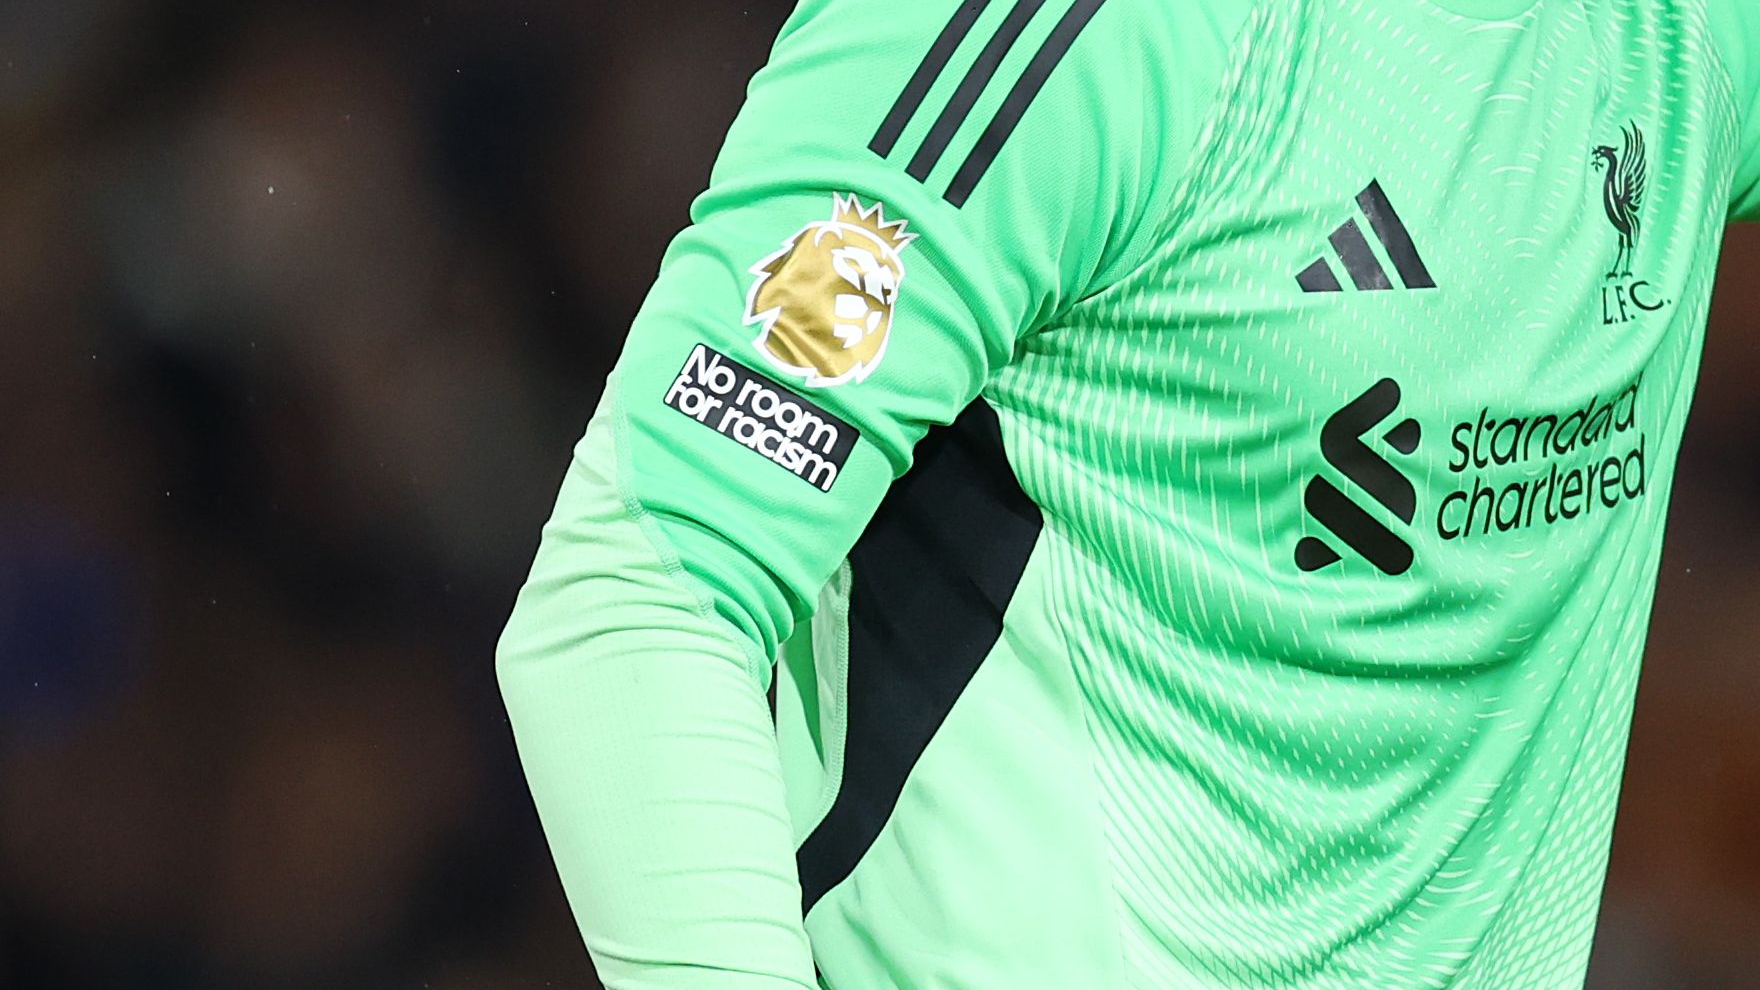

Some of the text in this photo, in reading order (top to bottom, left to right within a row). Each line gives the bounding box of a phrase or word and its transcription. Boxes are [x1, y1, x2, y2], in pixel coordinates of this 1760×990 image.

[1602, 280, 1672, 325] L.F.C.
[664, 373, 838, 492] for racism
[681, 344, 839, 455] No room
[1448, 370, 1644, 473] standard
[1436, 432, 1646, 541] chartered
